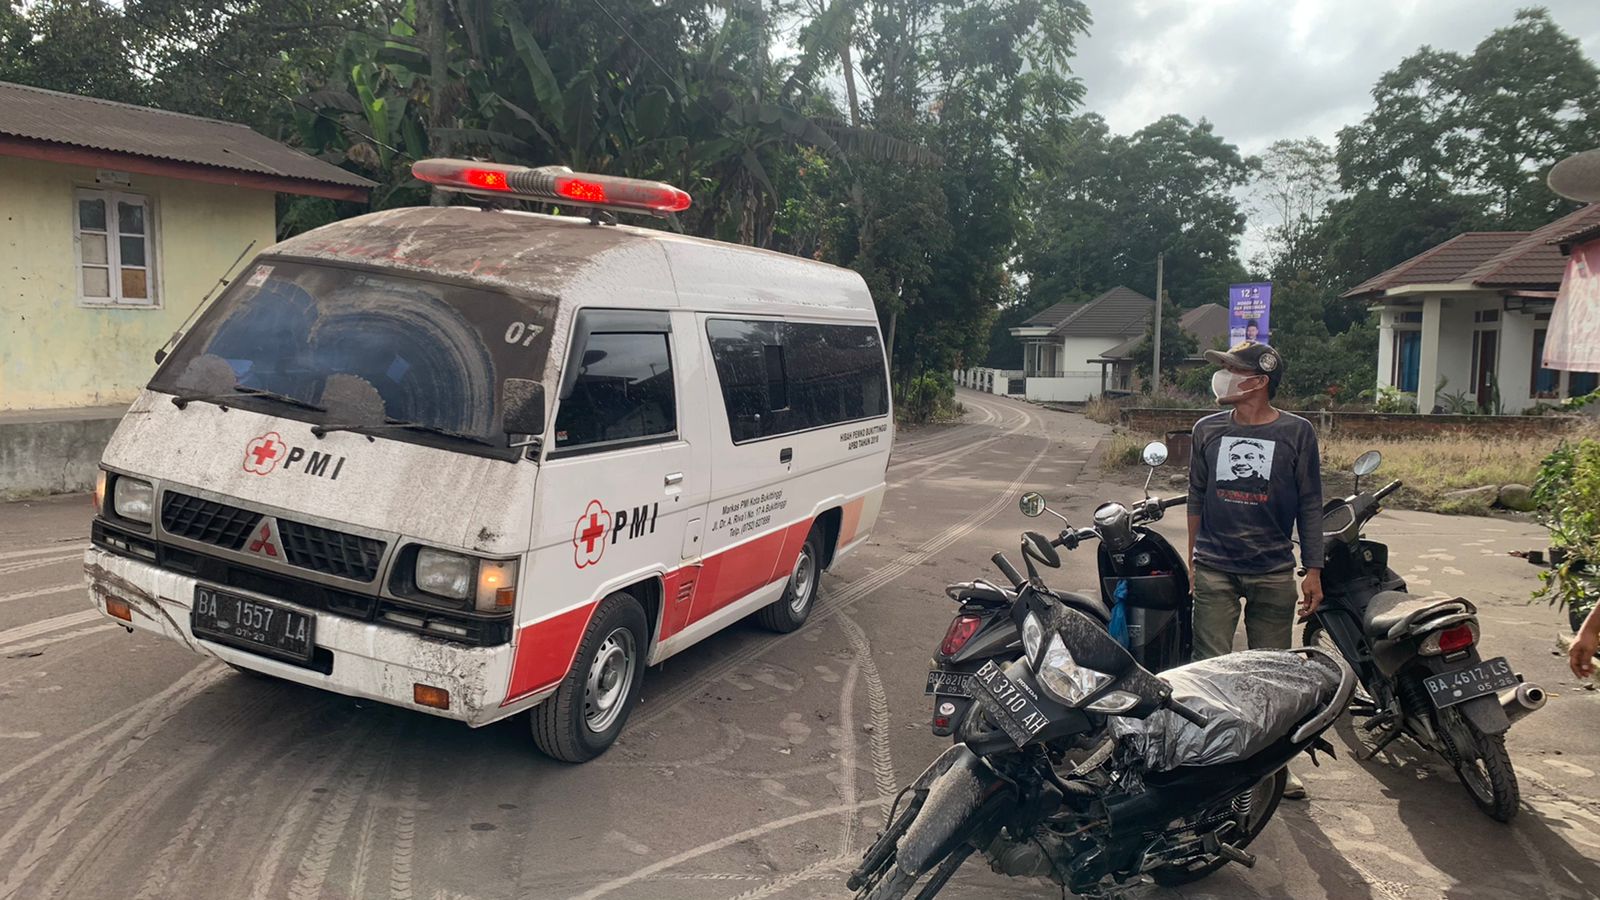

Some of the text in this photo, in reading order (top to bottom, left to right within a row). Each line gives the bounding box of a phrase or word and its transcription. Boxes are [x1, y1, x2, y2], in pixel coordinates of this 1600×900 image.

[1241, 288, 1251, 298] 12
[505, 321, 545, 347] 07
[283, 446, 346, 480] PMI
[722, 488, 783, 515] Markas PMI Kota Bukittinggi
[765, 500, 788, 514] Bukittinggi
[612, 502, 659, 545] PMI
[198, 592, 306, 642] BA 1557 LA
[1016, 678, 1039, 701] HONDA
[1428, 661, 1509, 693] BA 4617 LS
[976, 662, 999, 685] BA
[993, 679, 1027, 713] 3710
[1022, 711, 1048, 735] AH
